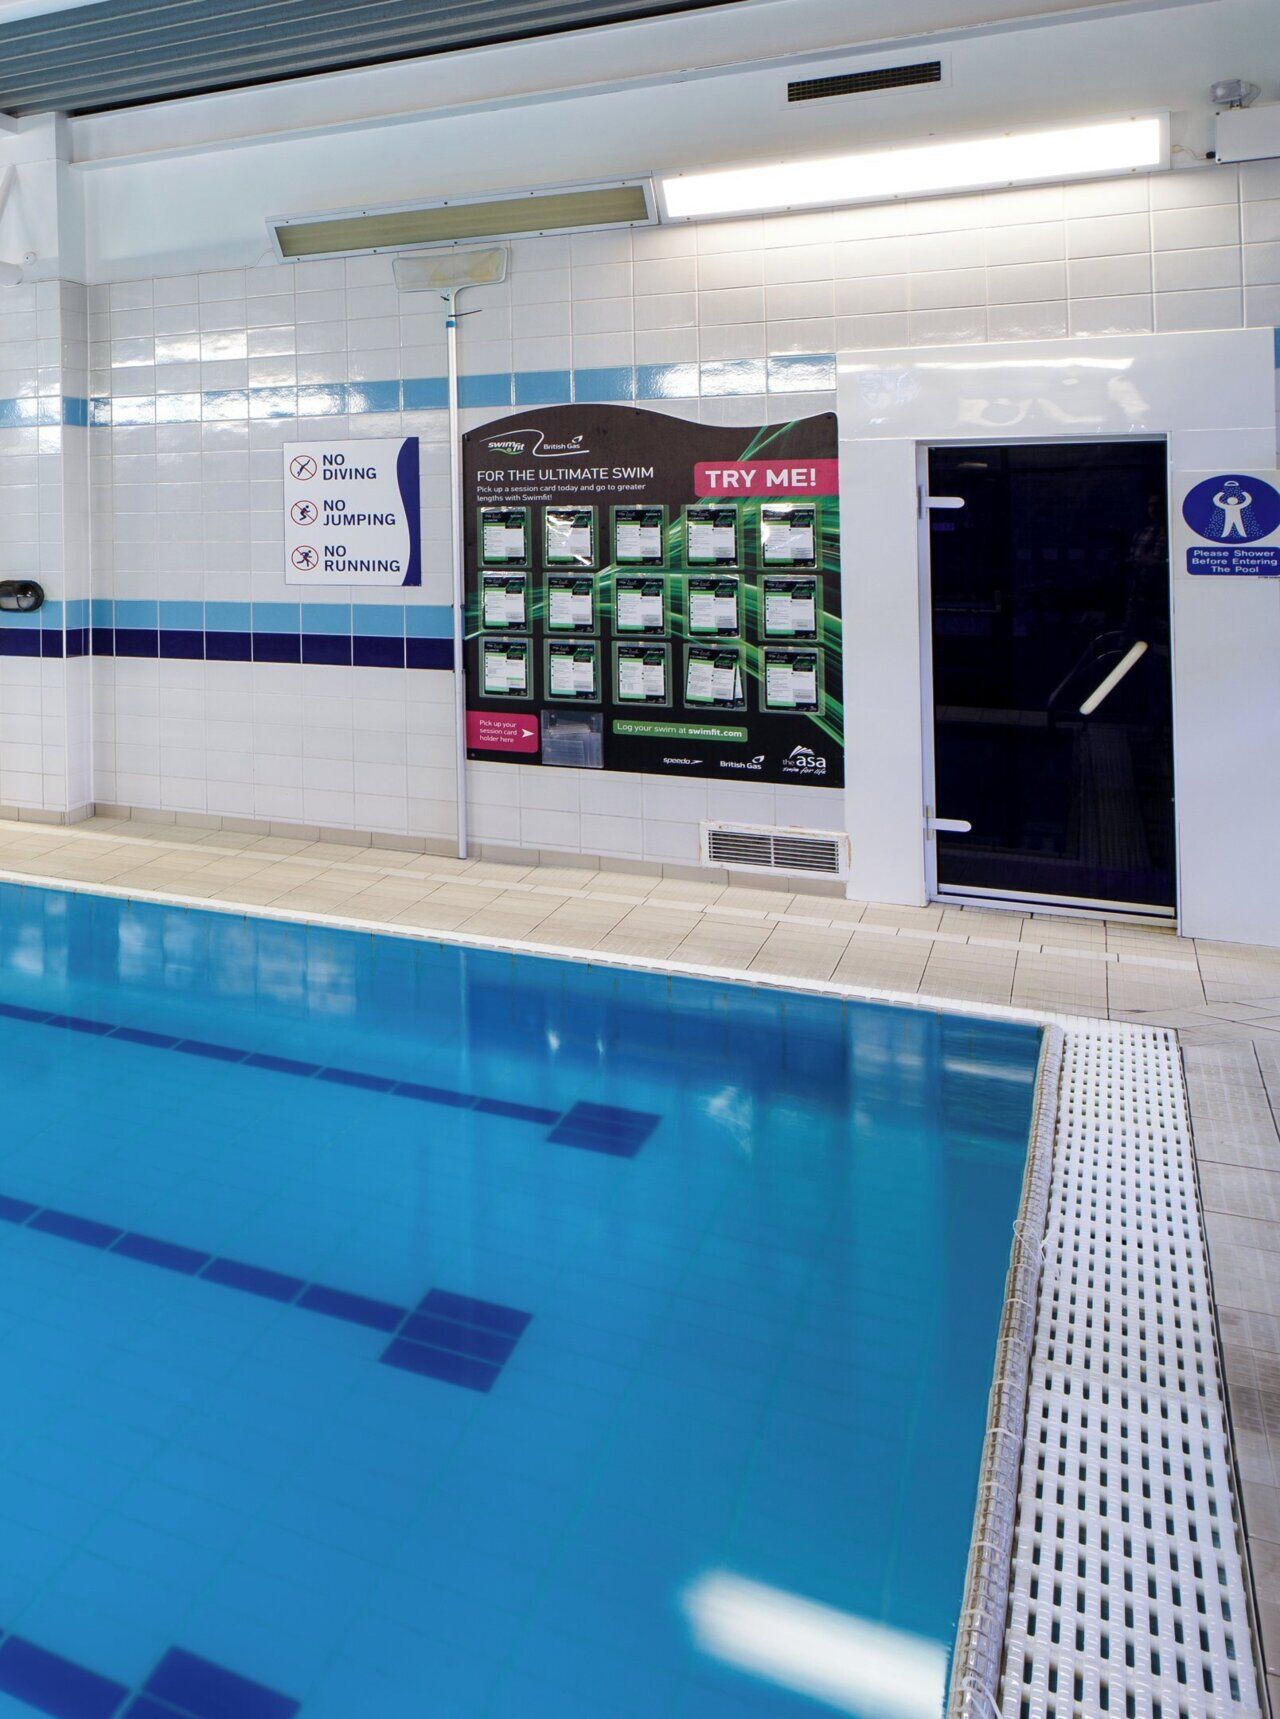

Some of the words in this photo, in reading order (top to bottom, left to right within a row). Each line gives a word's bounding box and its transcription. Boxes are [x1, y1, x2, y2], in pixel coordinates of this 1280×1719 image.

[488, 440, 525, 451] swimfit
[322, 454, 345, 466] NO
[323, 467, 377, 480] DIVING
[477, 470, 504, 482] FOR
[507, 469, 535, 481] THE
[538, 468, 609, 481] ULTIMATE
[612, 466, 654, 478] SWIM
[705, 469, 756, 488] TRY
[766, 468, 816, 488] ME!
[558, 484, 578, 493] today
[617, 484, 646, 492] greater
[323, 500, 346, 512] NO
[323, 513, 396, 526] JUMPING
[324, 545, 346, 557] NO
[324, 560, 400, 572] RUNNING
[1232, 558, 1278, 566] Entering
[617, 723, 633, 732] Log
[634, 724, 652, 733] your
[654, 726, 676, 734] swim
[688, 727, 742, 738] swimfit.com
[663, 757, 691, 765] speedo
[720, 760, 746, 769] British
[746, 762, 762, 770] Gas
[782, 758, 795, 767] the
[796, 756, 826, 768] asa
